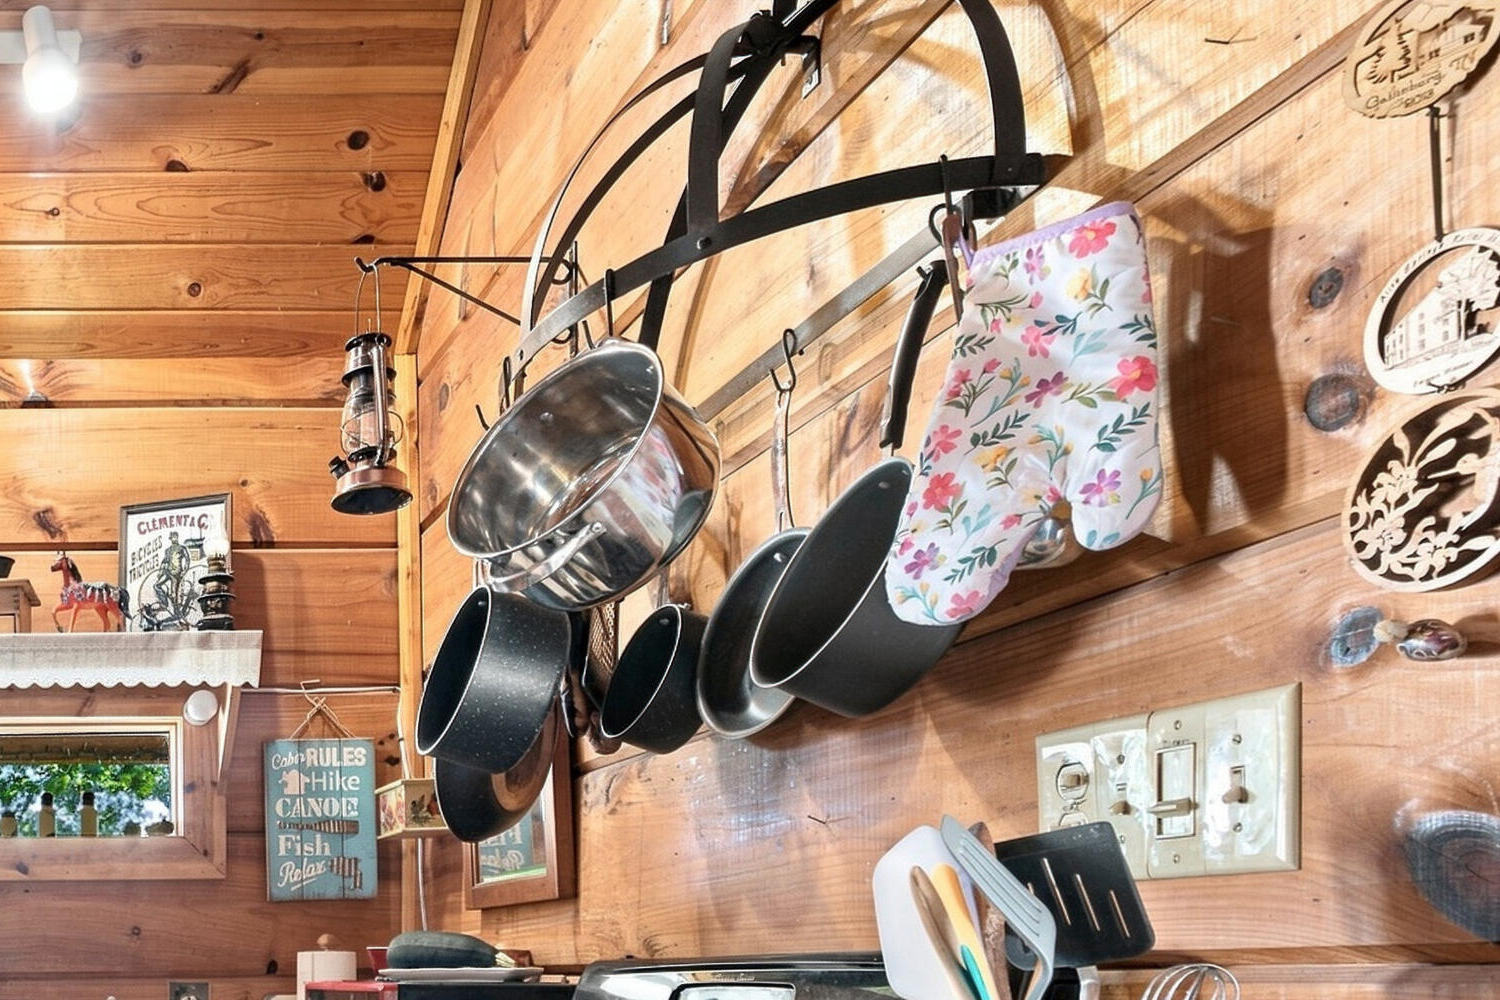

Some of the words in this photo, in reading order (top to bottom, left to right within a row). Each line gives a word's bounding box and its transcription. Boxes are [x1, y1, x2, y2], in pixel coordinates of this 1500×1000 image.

[271, 752, 306, 770] Cabin
[306, 747, 368, 768] RULES
[311, 770, 361, 792] Hike
[275, 797, 359, 818] CANOE
[277, 834, 332, 857] Fish
[277, 857, 327, 888] Relax
